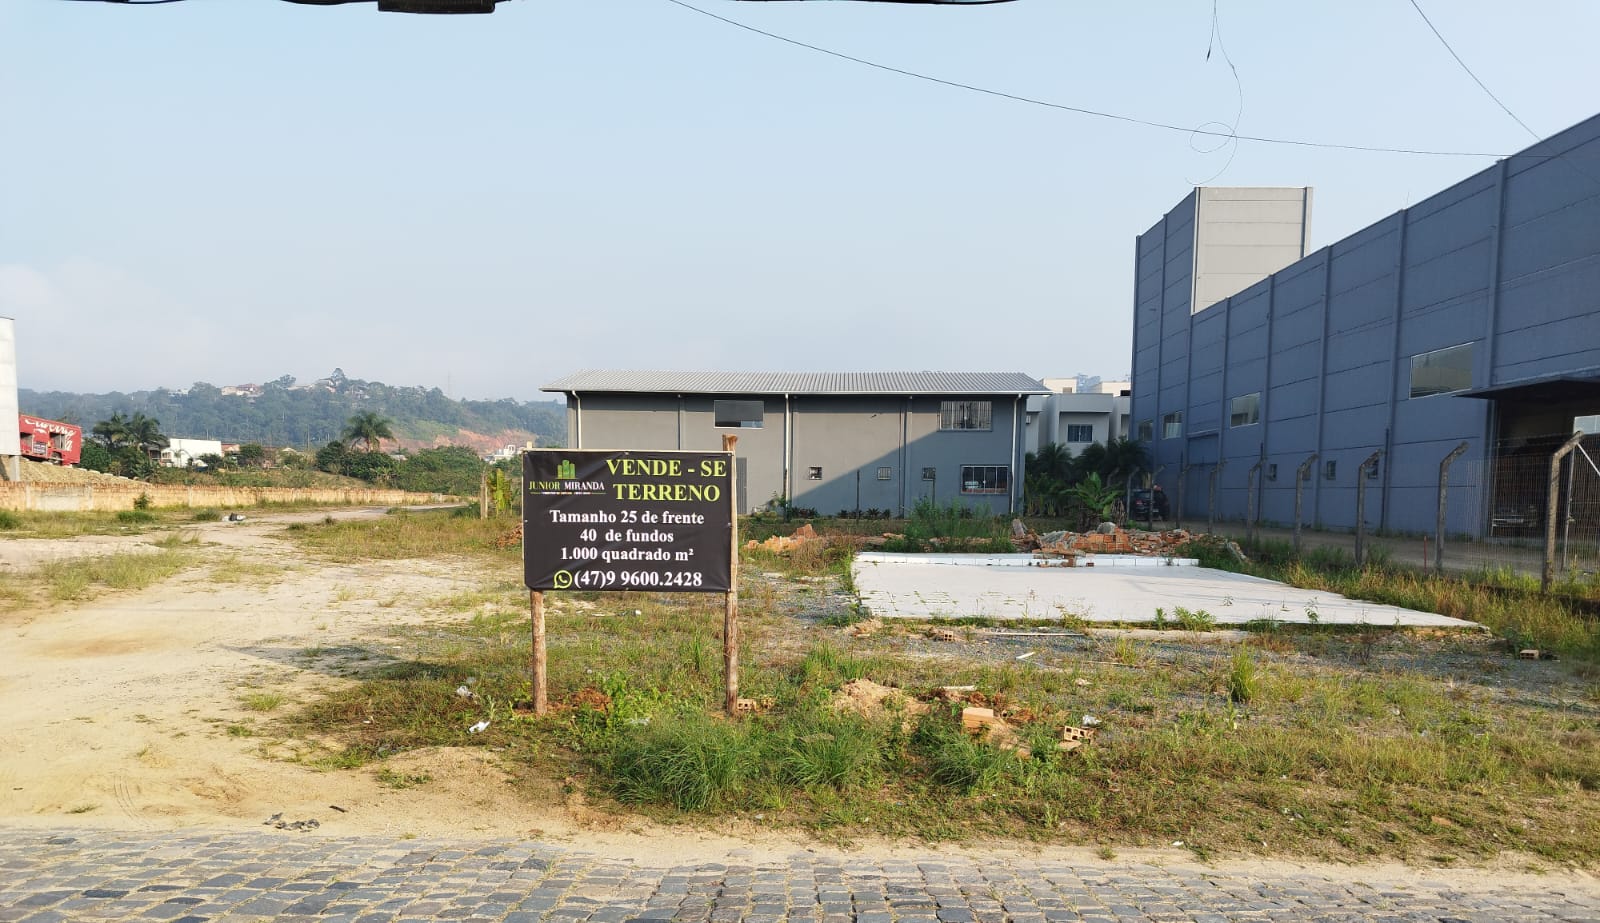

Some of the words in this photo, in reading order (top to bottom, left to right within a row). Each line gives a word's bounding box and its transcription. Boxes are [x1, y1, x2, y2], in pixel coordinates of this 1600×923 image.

[606, 459, 681, 476] VENDE
[700, 460, 726, 477] SE
[529, 481, 560, 490] JUNIOR
[564, 481, 604, 490] MIRANDA
[613, 484, 721, 501] TERRENO
[550, 510, 616, 523] Tamanho
[620, 511, 637, 523] 25
[642, 511, 659, 524] de
[662, 510, 704, 524] frente
[580, 529, 597, 541] 40
[605, 529, 622, 542] de
[626, 529, 674, 542] fundos
[560, 547, 598, 560] 1.000
[602, 548, 671, 563] quadrado
[675, 549, 694, 561] m²
[574, 571, 616, 588] (47)9
[620, 572, 703, 587] 9600.2428
